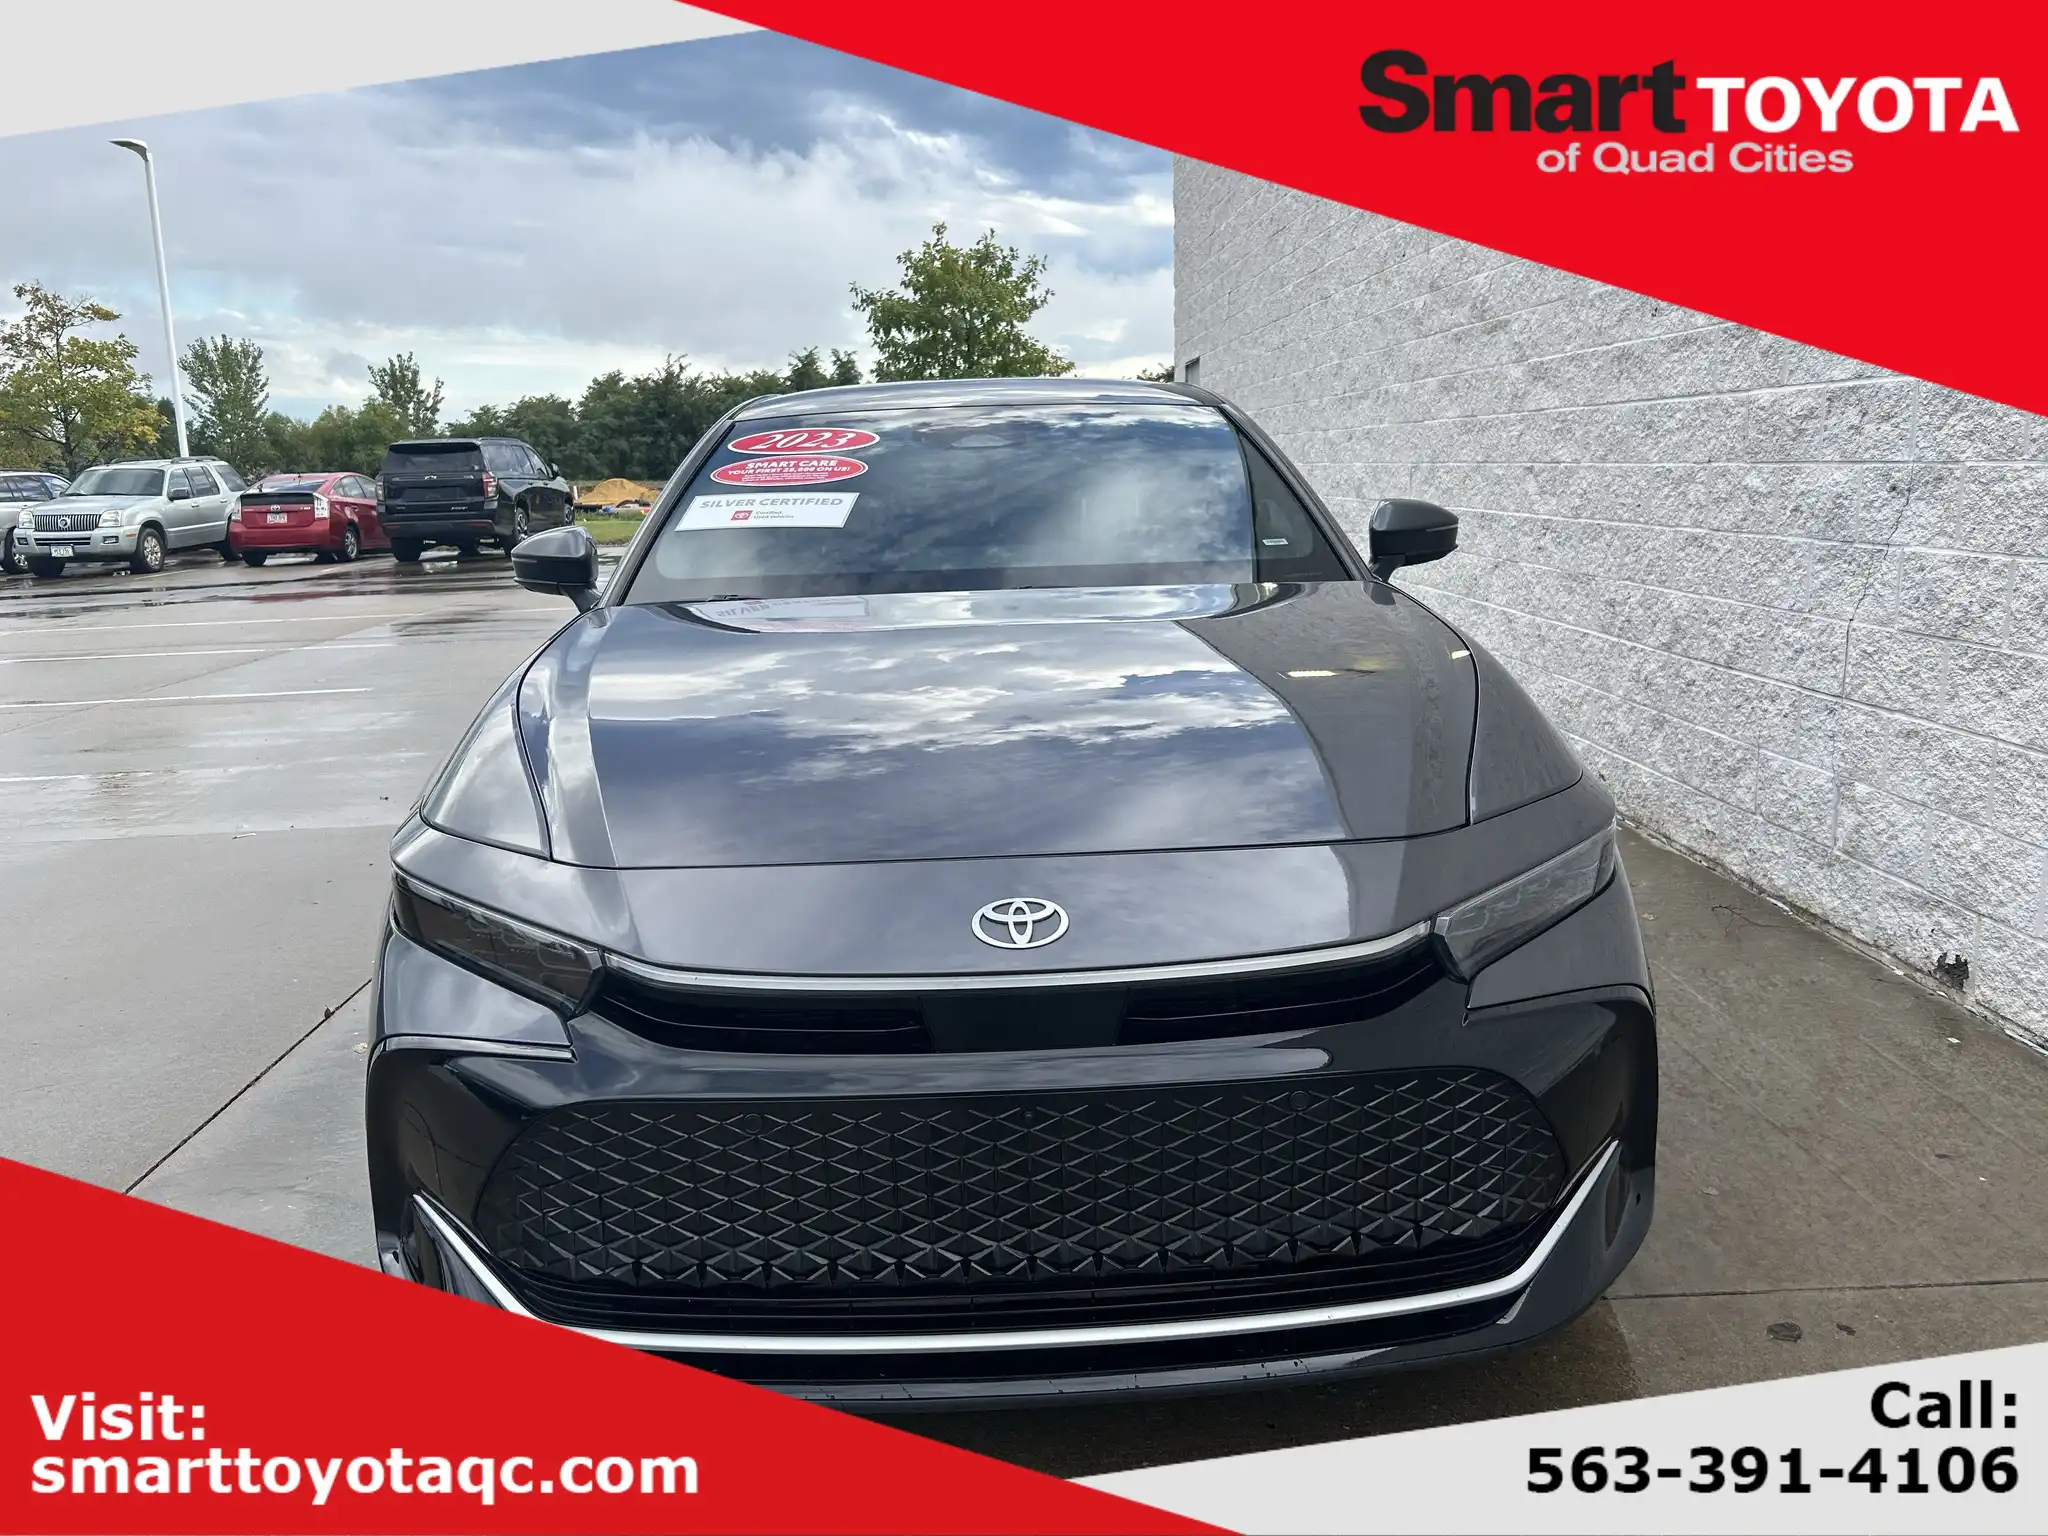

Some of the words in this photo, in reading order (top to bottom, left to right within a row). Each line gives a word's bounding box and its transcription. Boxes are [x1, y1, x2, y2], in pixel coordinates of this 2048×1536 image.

[748, 432, 857, 450] 2023
[745, 461, 797, 470] SMART
[798, 459, 839, 468] CARE
[700, 498, 757, 508] SILVER
[758, 497, 844, 507] CERTIFIED
